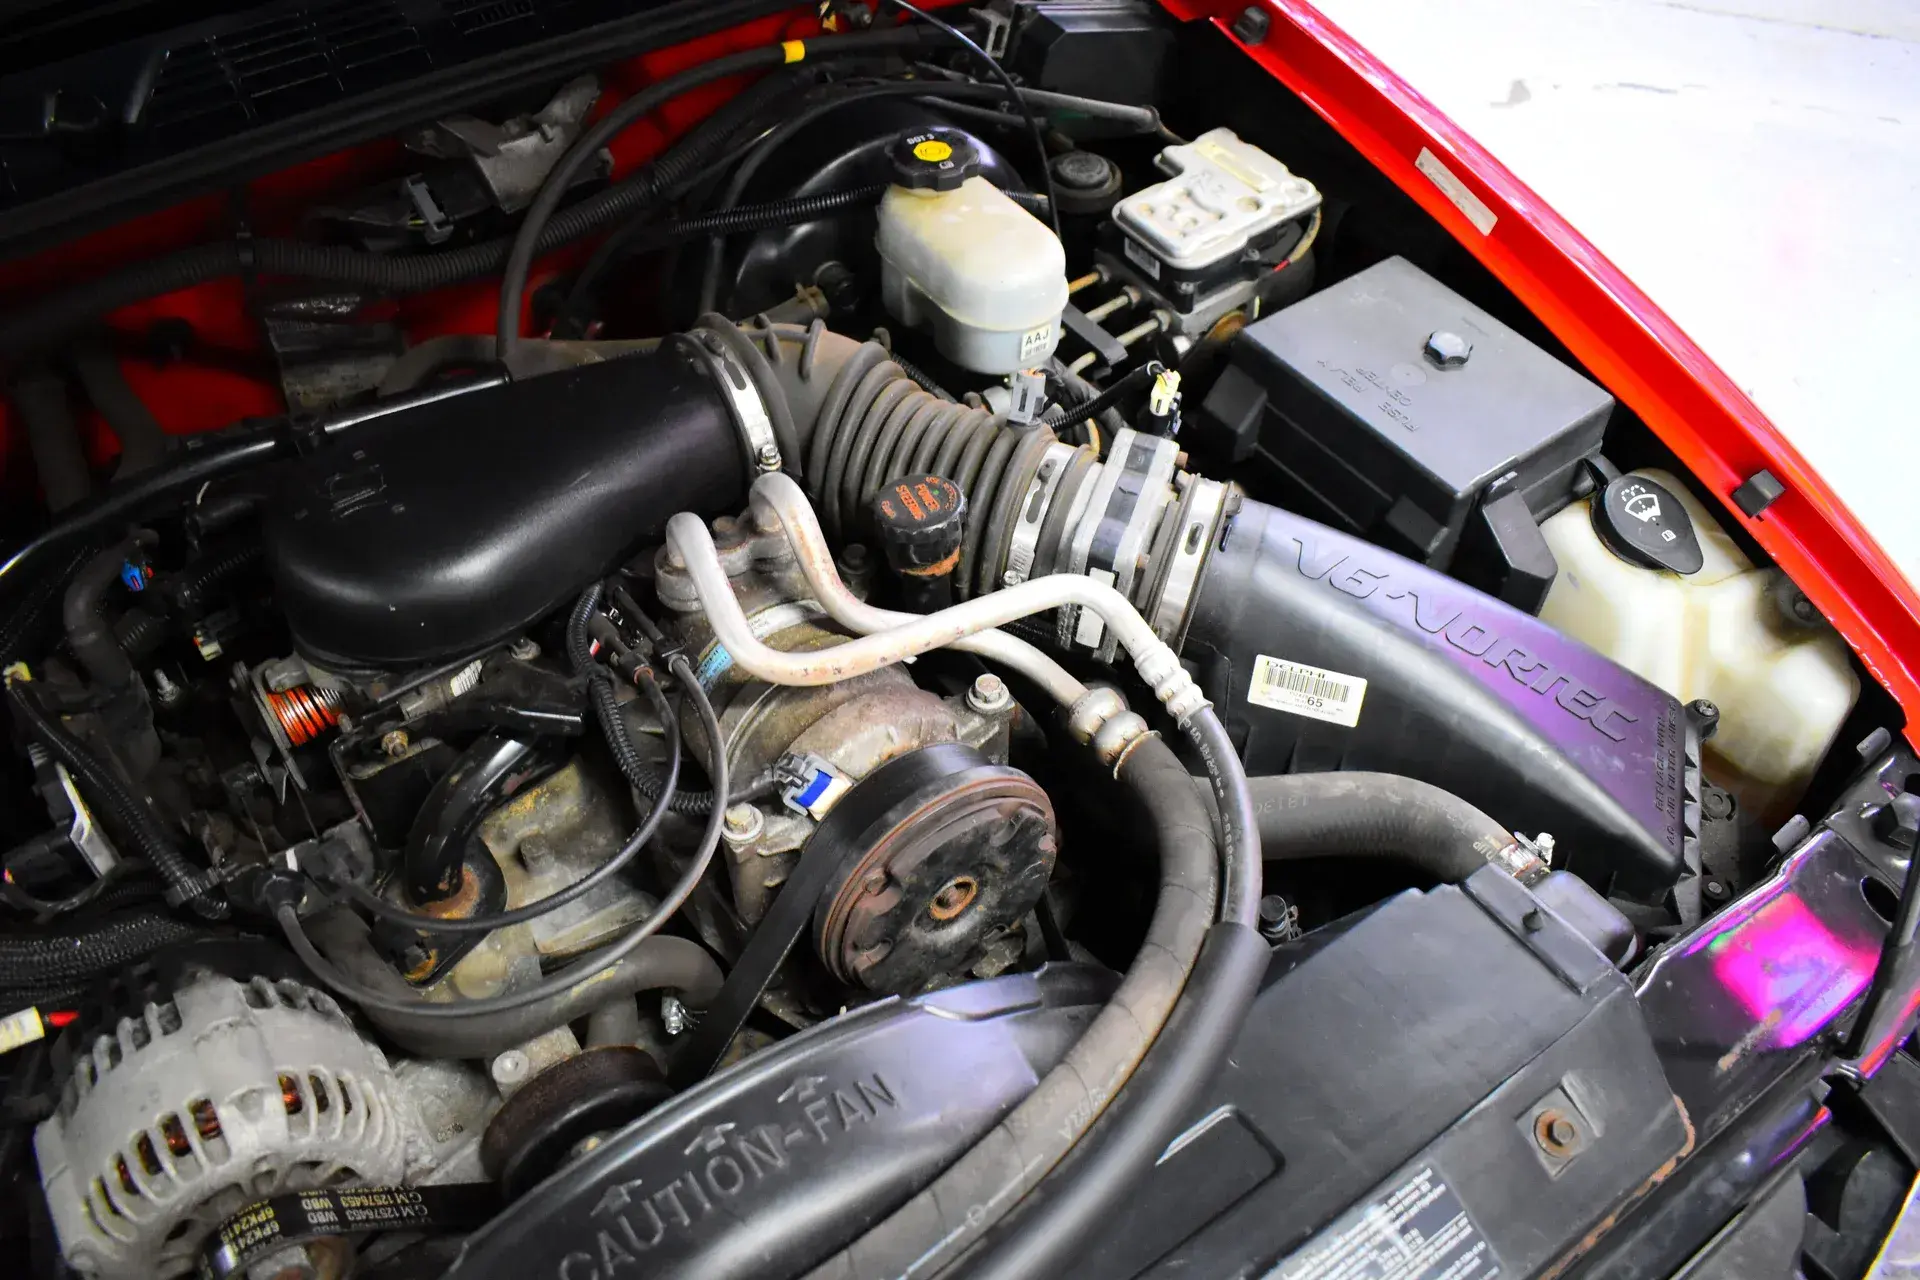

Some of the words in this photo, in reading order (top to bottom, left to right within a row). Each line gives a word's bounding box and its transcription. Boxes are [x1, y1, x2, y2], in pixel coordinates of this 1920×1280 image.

[1024, 328, 1049, 347] AAJ
[1266, 661, 1326, 679] DELPHI
[302, 1196, 334, 1211] WBD
[394, 1190, 423, 1206] GM
[307, 1210, 339, 1224] WBD
[399, 1204, 428, 1218] GM
